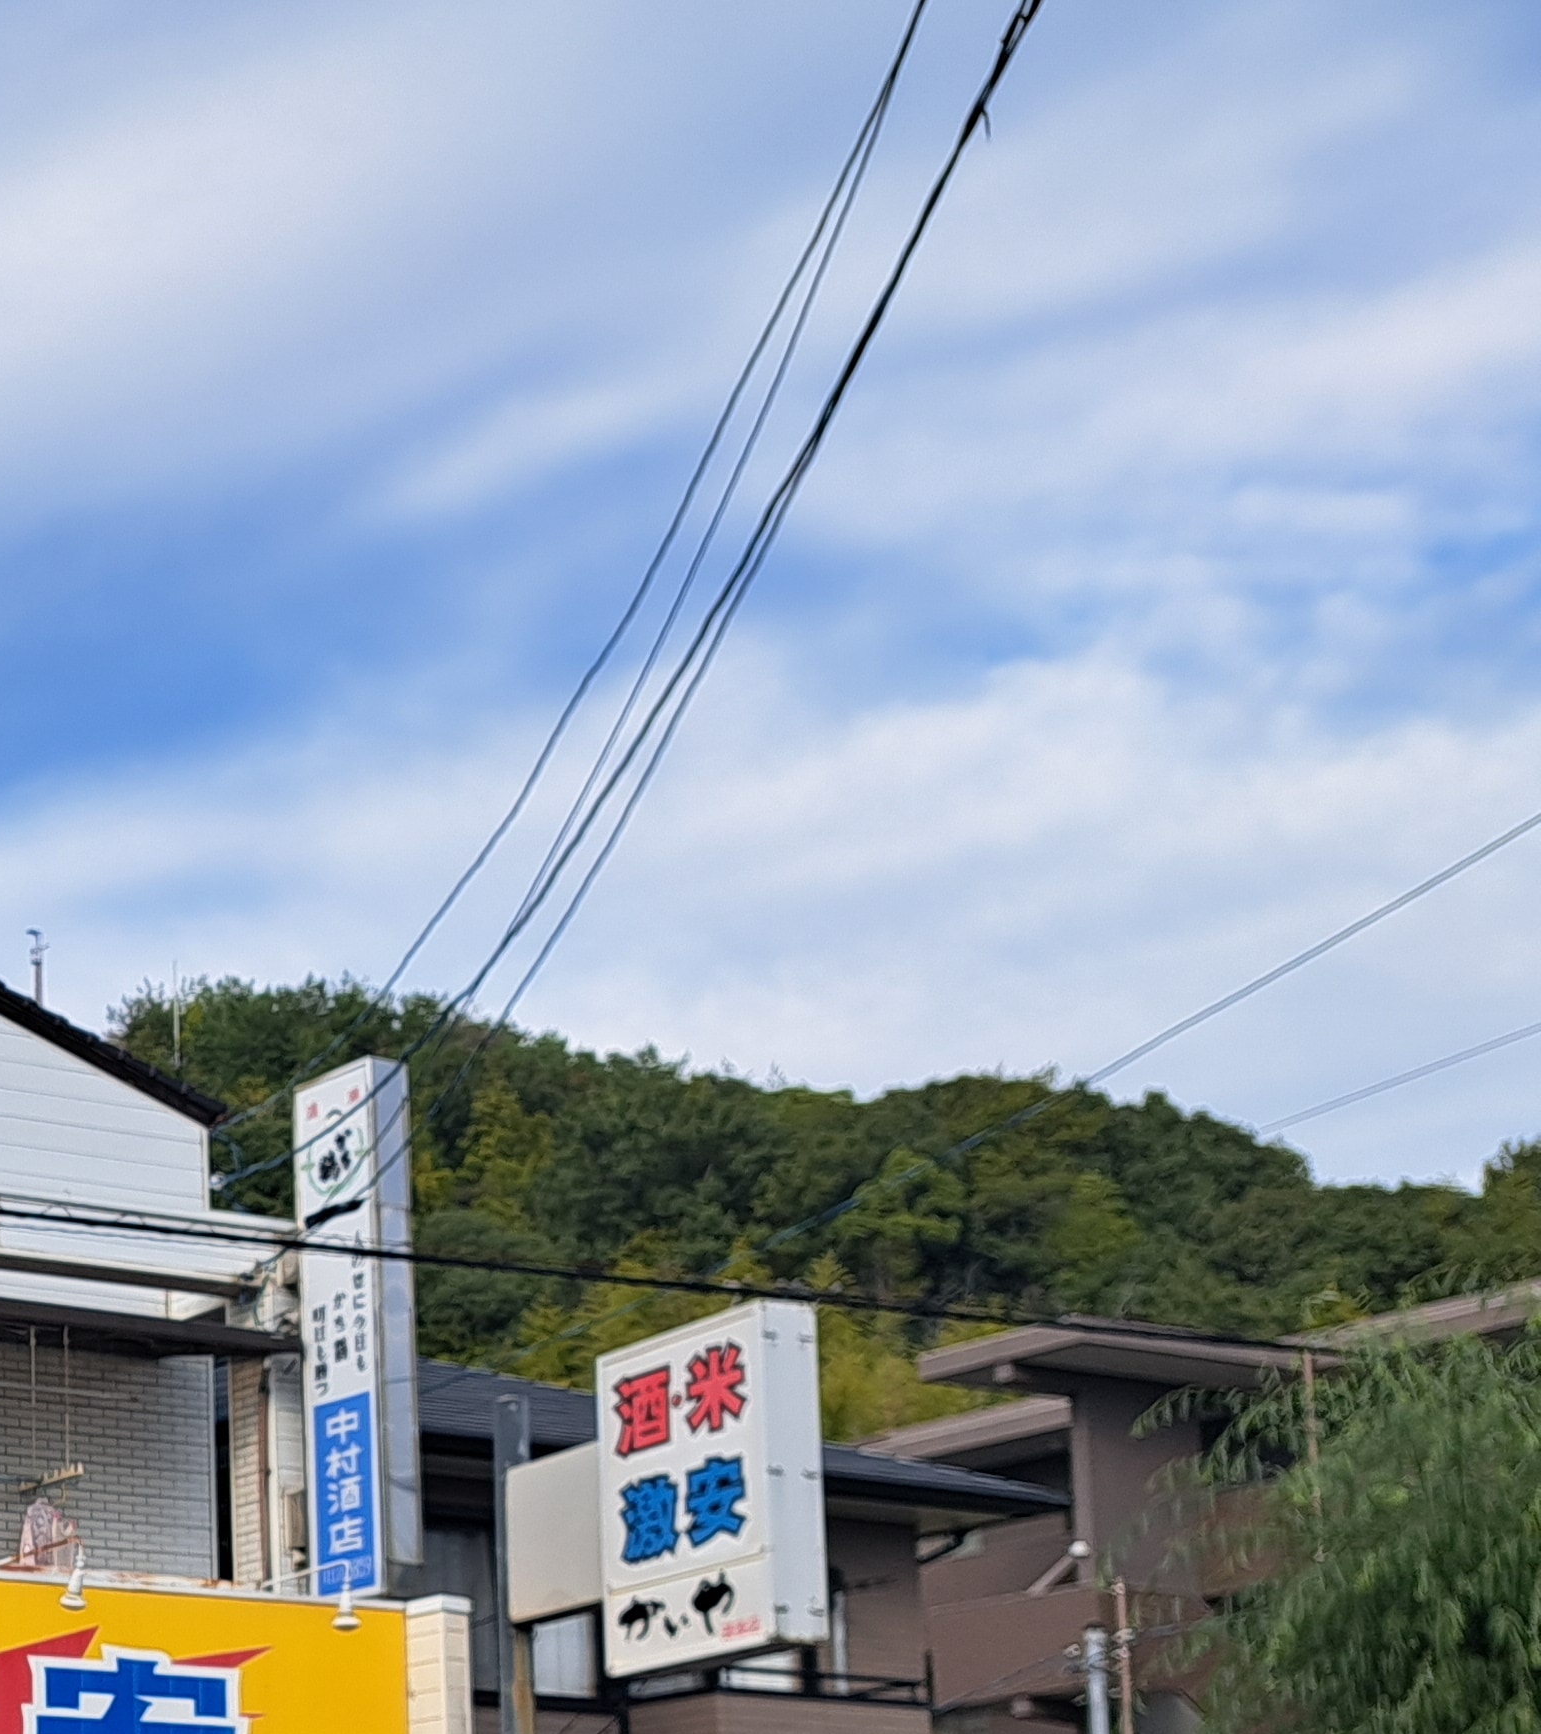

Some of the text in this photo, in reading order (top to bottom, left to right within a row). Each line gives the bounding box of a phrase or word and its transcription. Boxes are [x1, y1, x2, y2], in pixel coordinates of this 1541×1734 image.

[611, 1342, 748, 1457] 酒・米
[324, 1406, 367, 1556] 中村酒店
[619, 1457, 748, 1563] 激安
